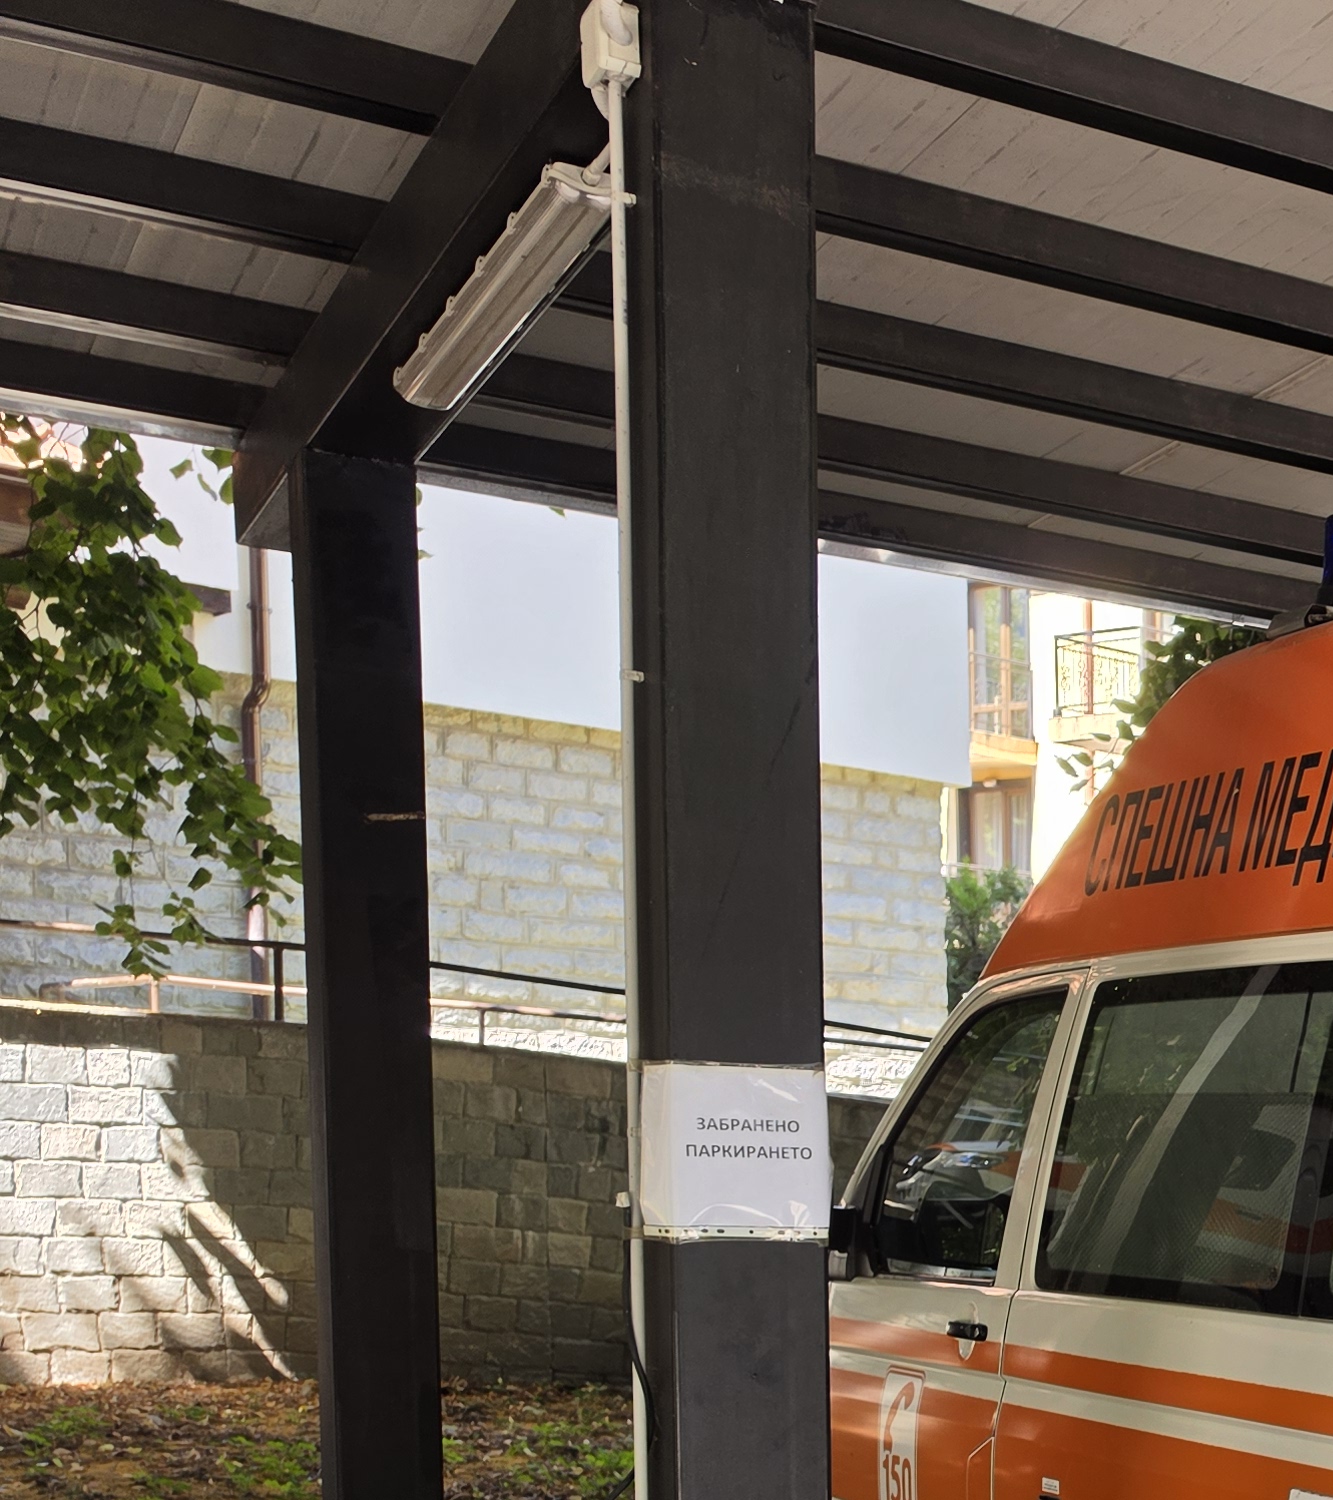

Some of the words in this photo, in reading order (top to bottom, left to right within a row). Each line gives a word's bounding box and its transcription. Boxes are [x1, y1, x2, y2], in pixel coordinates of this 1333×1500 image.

[1083, 764, 1240, 897] СПЕШНА
[696, 1117, 801, 1133] ЗАБРАНЕНО
[685, 1144, 813, 1160] ПАРКИРАНЕТО
